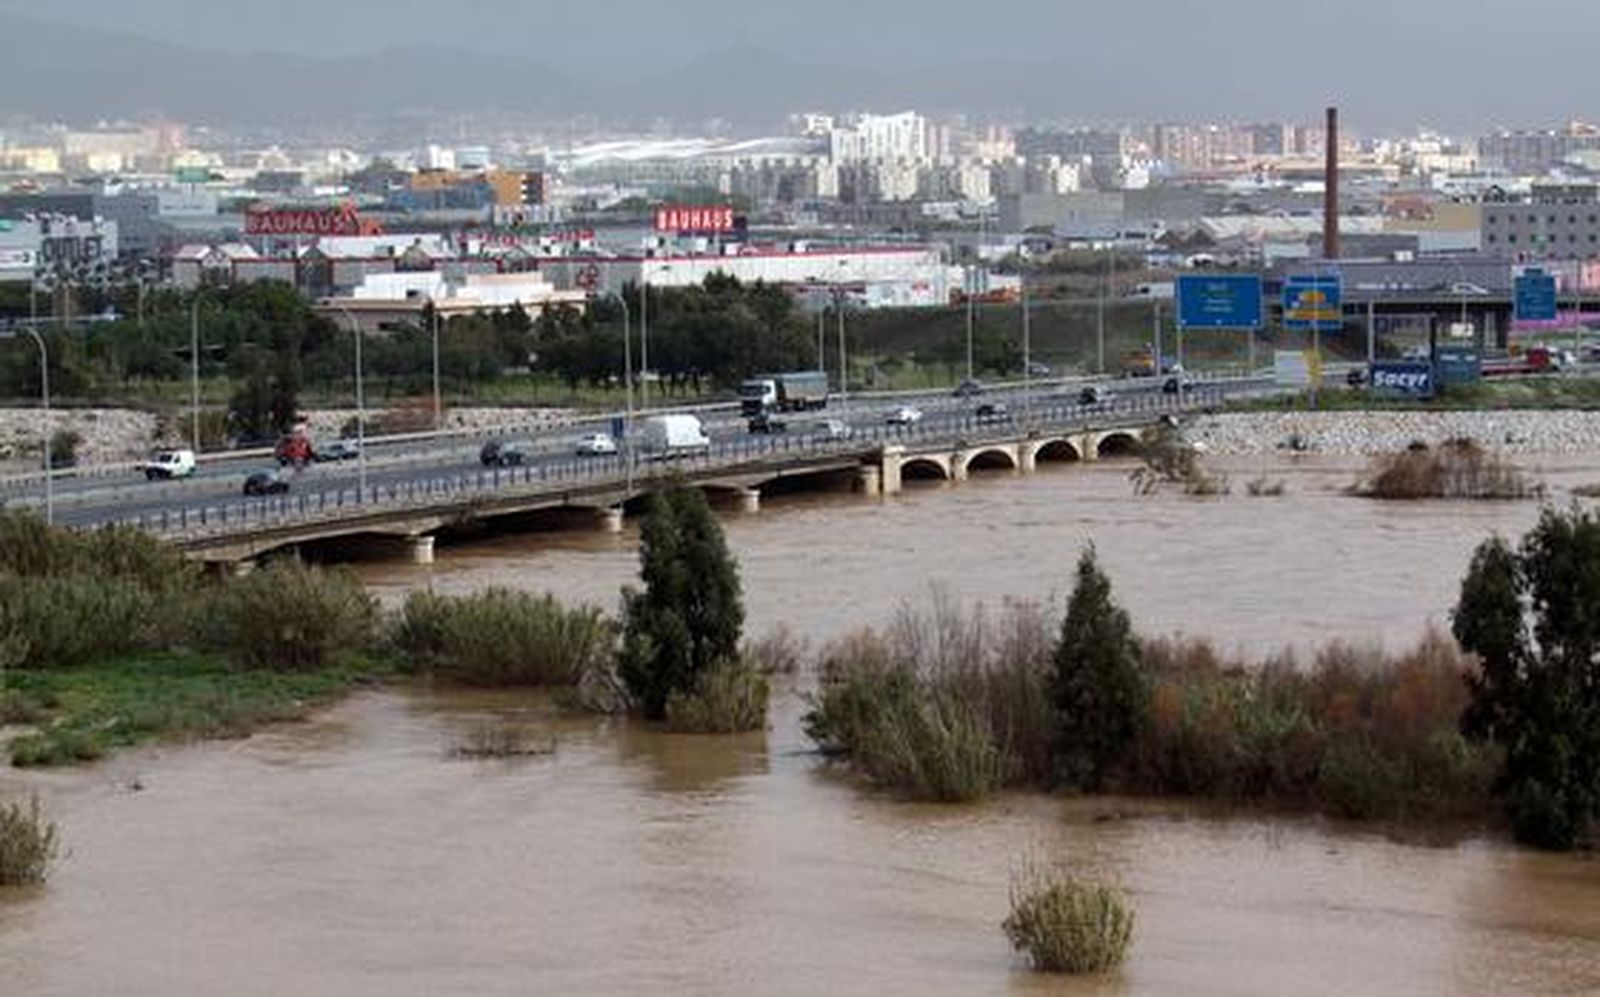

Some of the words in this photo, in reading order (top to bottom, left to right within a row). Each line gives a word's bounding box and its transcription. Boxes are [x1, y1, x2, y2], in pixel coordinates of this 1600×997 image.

[246, 213, 346, 234] BAUHAUS
[657, 208, 733, 231] BAUHAUS
[1373, 370, 1428, 389] Sacyr
